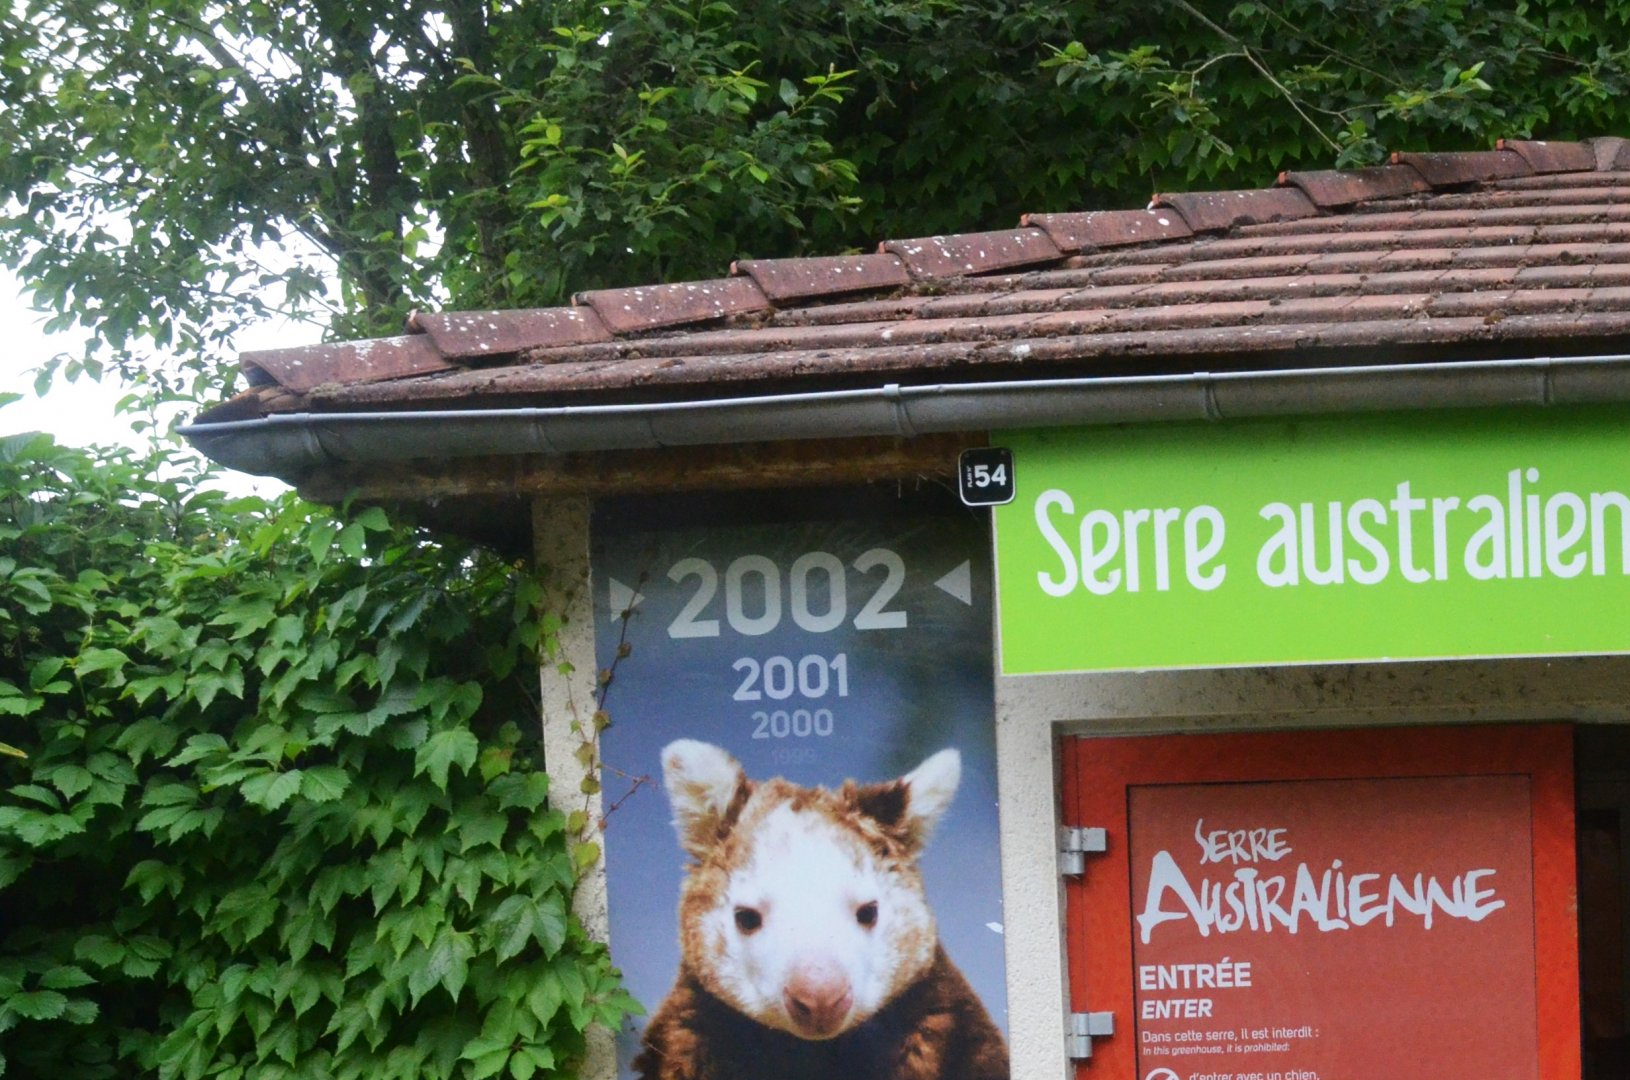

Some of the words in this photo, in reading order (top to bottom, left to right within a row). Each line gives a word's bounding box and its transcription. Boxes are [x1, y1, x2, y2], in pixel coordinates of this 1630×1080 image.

[974, 463, 1007, 488] 54
[1036, 488, 1228, 598] Serre
[666, 547, 907, 639] 2002
[732, 653, 849, 701] 2001
[751, 708, 834, 739] 2000
[1194, 818, 1293, 865] SERRE
[1139, 957, 1252, 991] ENTRÉE
[1141, 998, 1213, 1020] ENTER
[1142, 1030, 1172, 1043] Dans
[1174, 1030, 1202, 1042] cette
[1206, 1029, 1238, 1042] serre,
[1252, 1028, 1268, 1039] est
[1272, 1026, 1312, 1038] interdit
[1143, 1047, 1152, 1056] In
[1154, 1046, 1170, 1055] this
[1226, 1044, 1233, 1053] it
[1235, 1044, 1242, 1052] is
